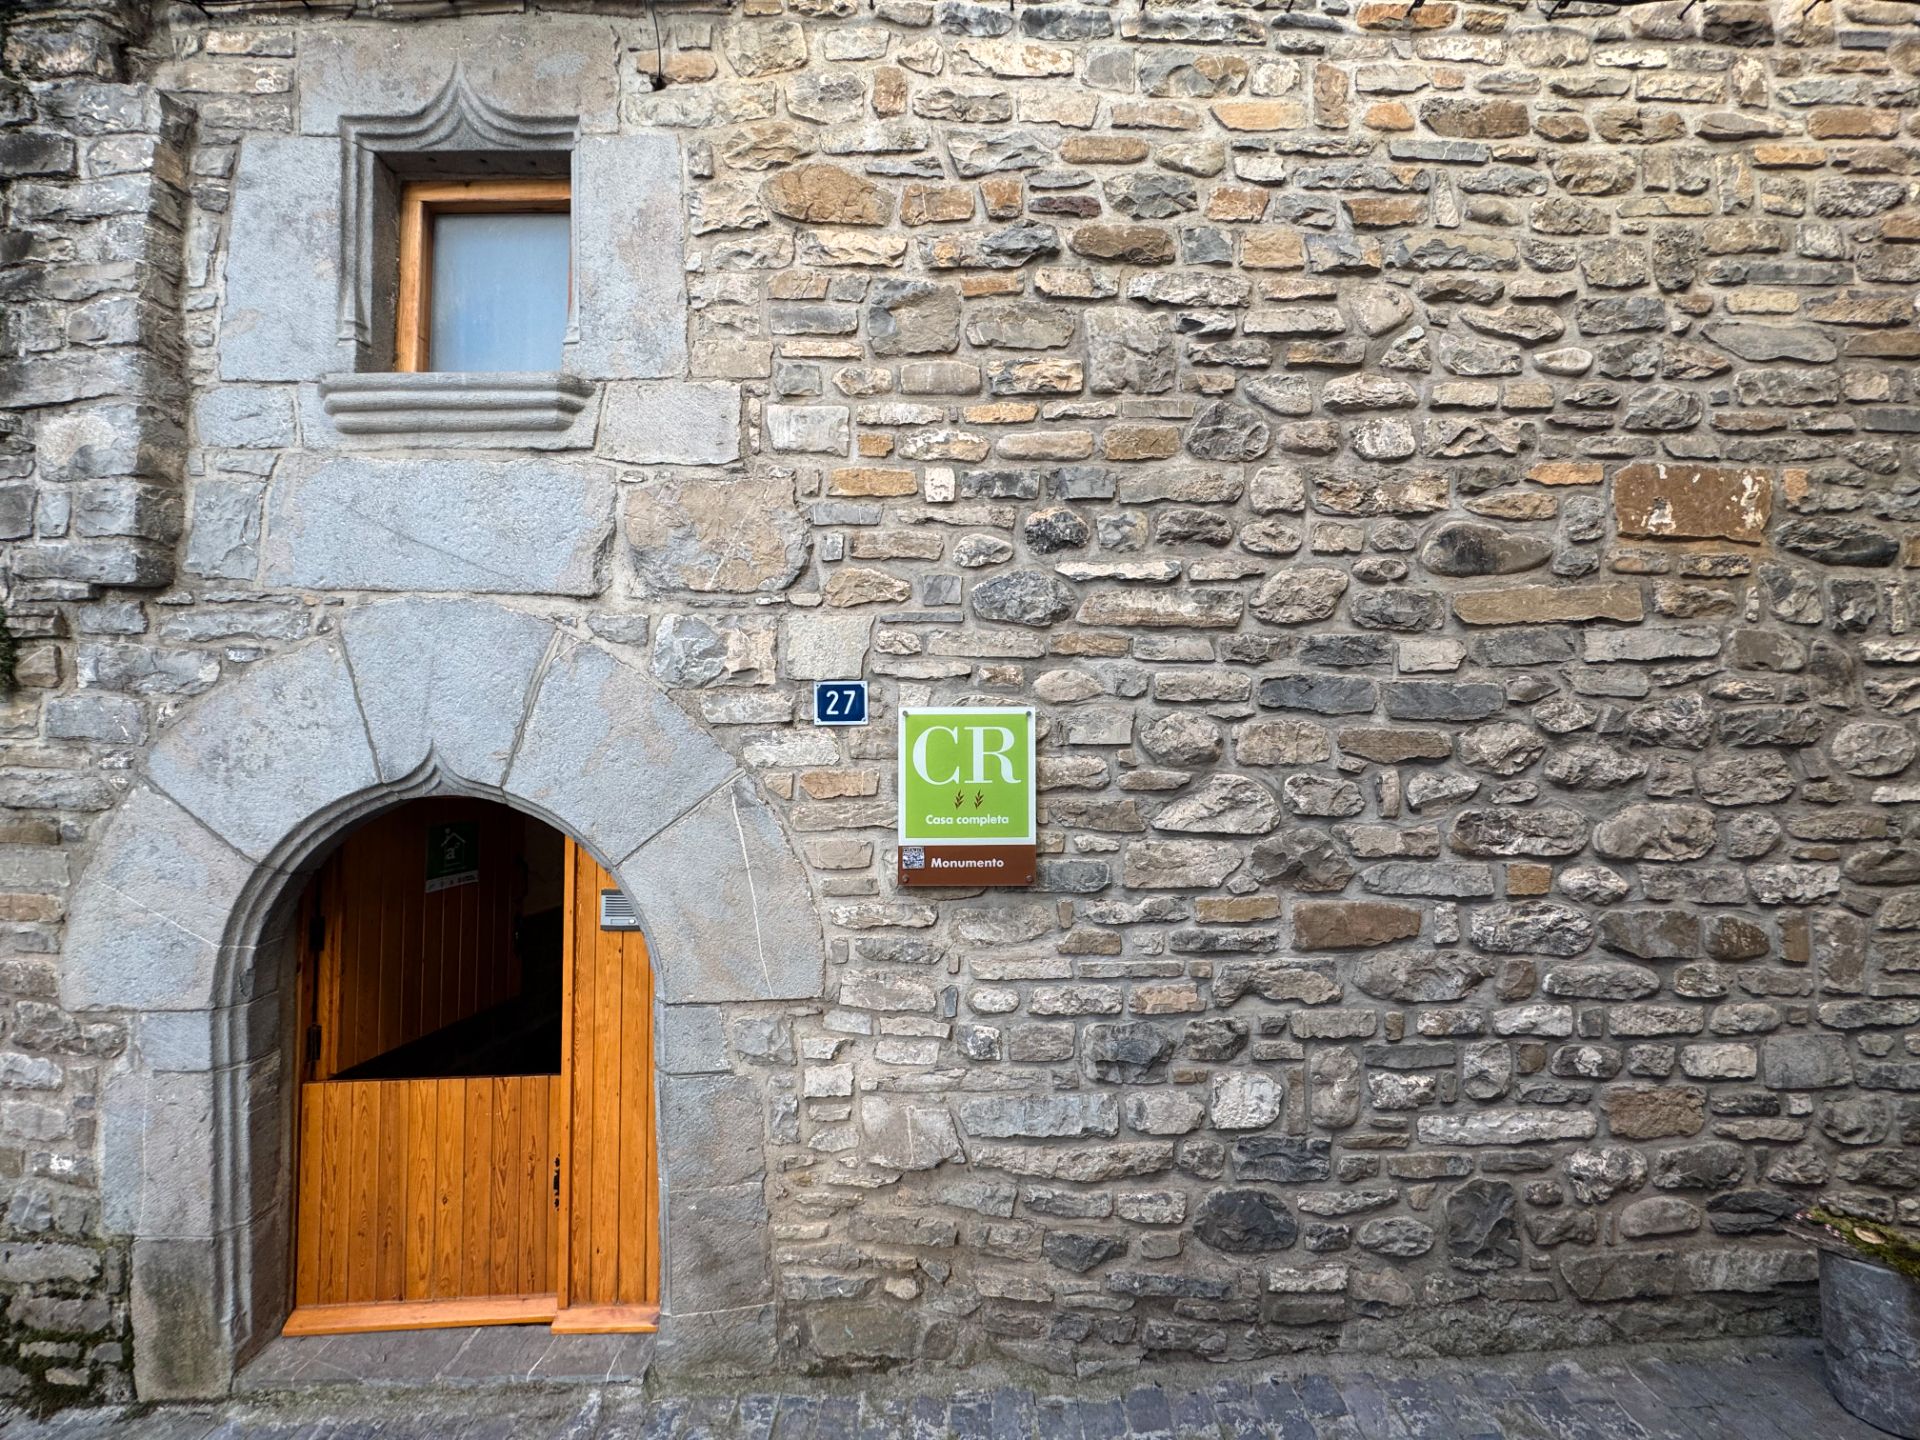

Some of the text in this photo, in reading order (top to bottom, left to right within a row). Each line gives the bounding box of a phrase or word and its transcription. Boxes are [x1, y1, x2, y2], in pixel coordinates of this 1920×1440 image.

[826, 690, 856, 715] 27
[912, 726, 1022, 786] CR
[925, 813, 1009, 827] Casa completa
[930, 857, 1005, 869] Monumento
